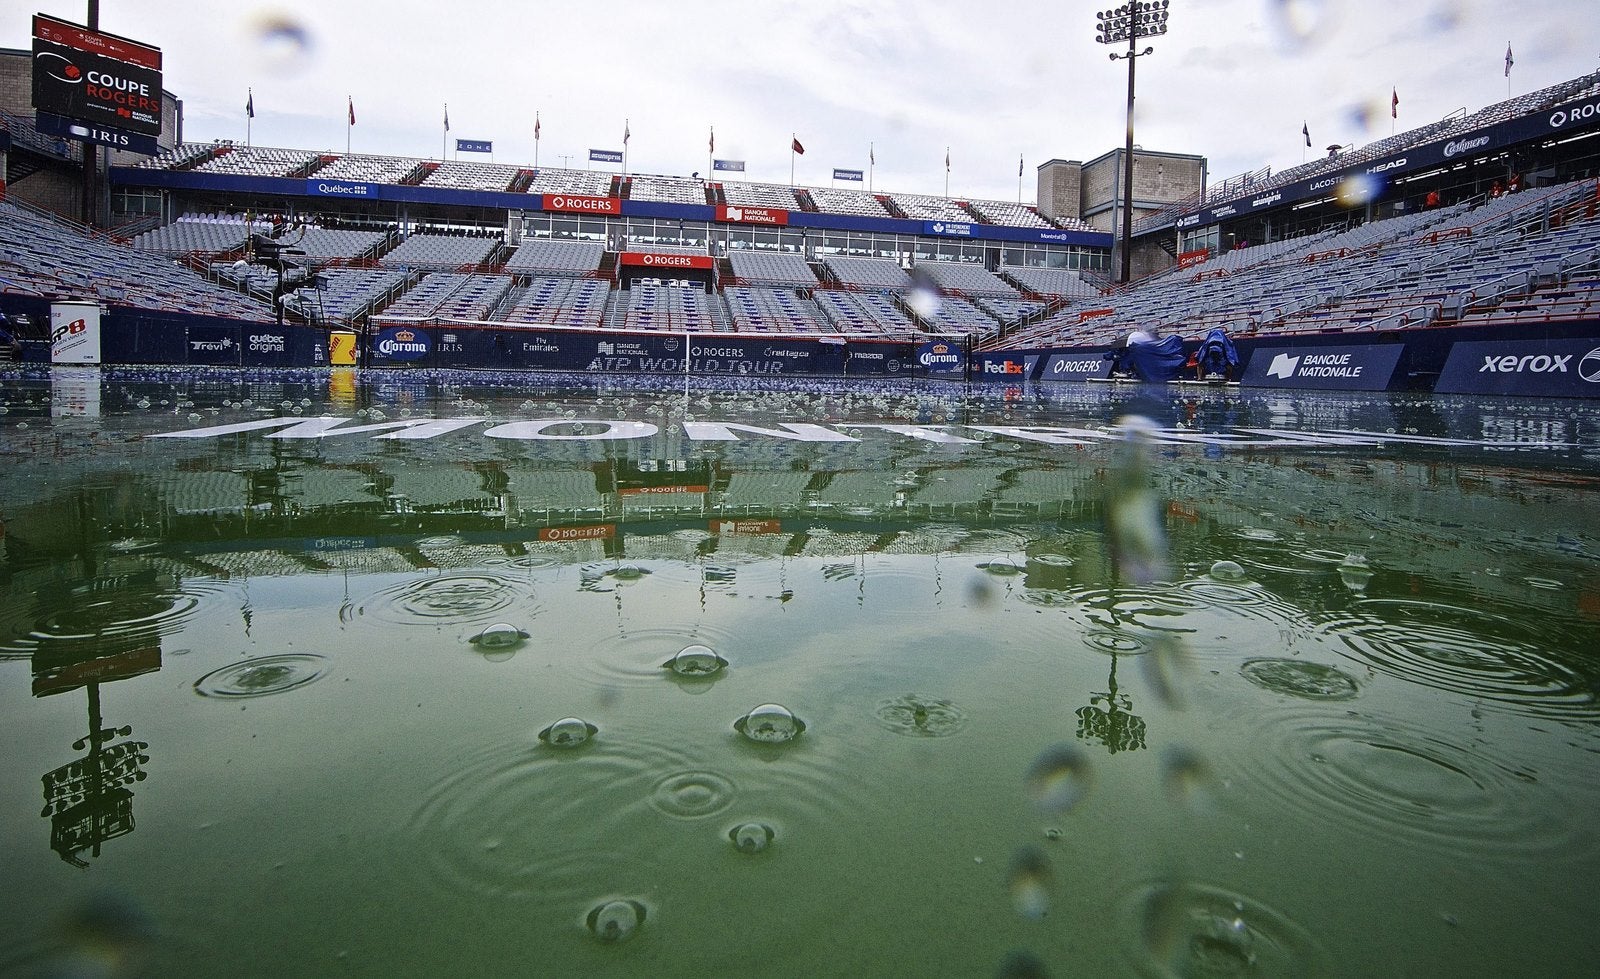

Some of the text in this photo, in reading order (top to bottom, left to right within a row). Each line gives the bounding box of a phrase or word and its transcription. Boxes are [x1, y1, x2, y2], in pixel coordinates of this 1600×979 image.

[87, 71, 149, 97] COUPE
[87, 84, 159, 112] ROGERS
[92, 129, 129, 146] IRIS
[1366, 158, 1407, 174] HEAD
[318, 183, 354, 194] Québec
[1310, 175, 1345, 191] LACOSTE
[566, 199, 613, 211] ROGERS
[744, 209, 769, 217] BANQUE
[744, 215, 776, 223] NATIONALE
[655, 257, 692, 266] ROGERS
[249, 334, 285, 344] québec
[249, 342, 285, 354] original
[380, 339, 427, 355] Corona
[437, 344, 463, 352] IRIS
[523, 343, 561, 352] Emirates
[616, 348, 649, 356] NATIONALE
[704, 347, 745, 357] ROGERS
[920, 352, 959, 366] Corona
[1303, 354, 1352, 366] BANQUE
[1479, 354, 1573, 374] xerox
[586, 358, 784, 374] ATP WORLD TOUR
[985, 360, 1023, 374] FedEx
[1062, 360, 1103, 373] ROGERS
[1298, 366, 1363, 379] NATIONALE
